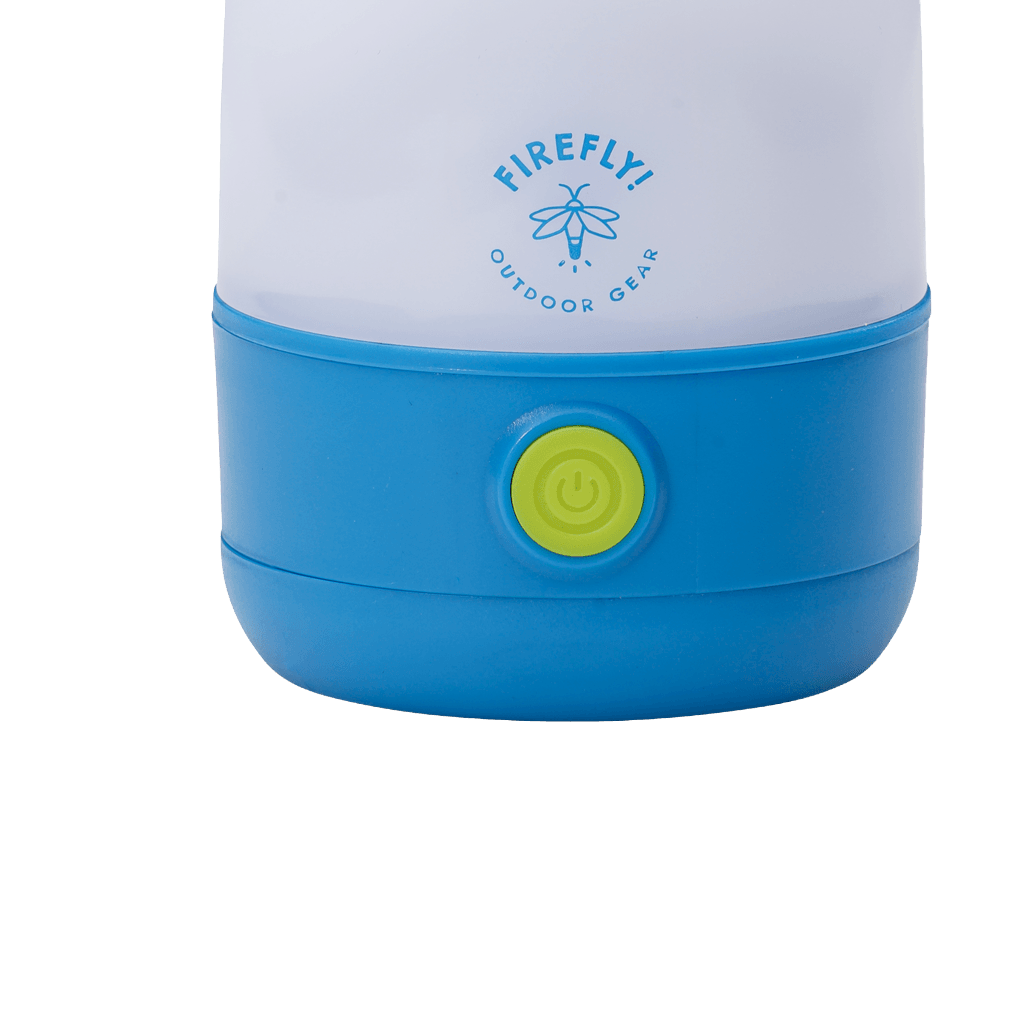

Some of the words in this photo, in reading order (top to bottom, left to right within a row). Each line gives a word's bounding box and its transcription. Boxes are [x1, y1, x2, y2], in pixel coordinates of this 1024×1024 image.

[493, 132, 654, 193] FIREFLY!
[490, 248, 594, 313] OUTDOOR
[609, 248, 658, 302] GEAR
